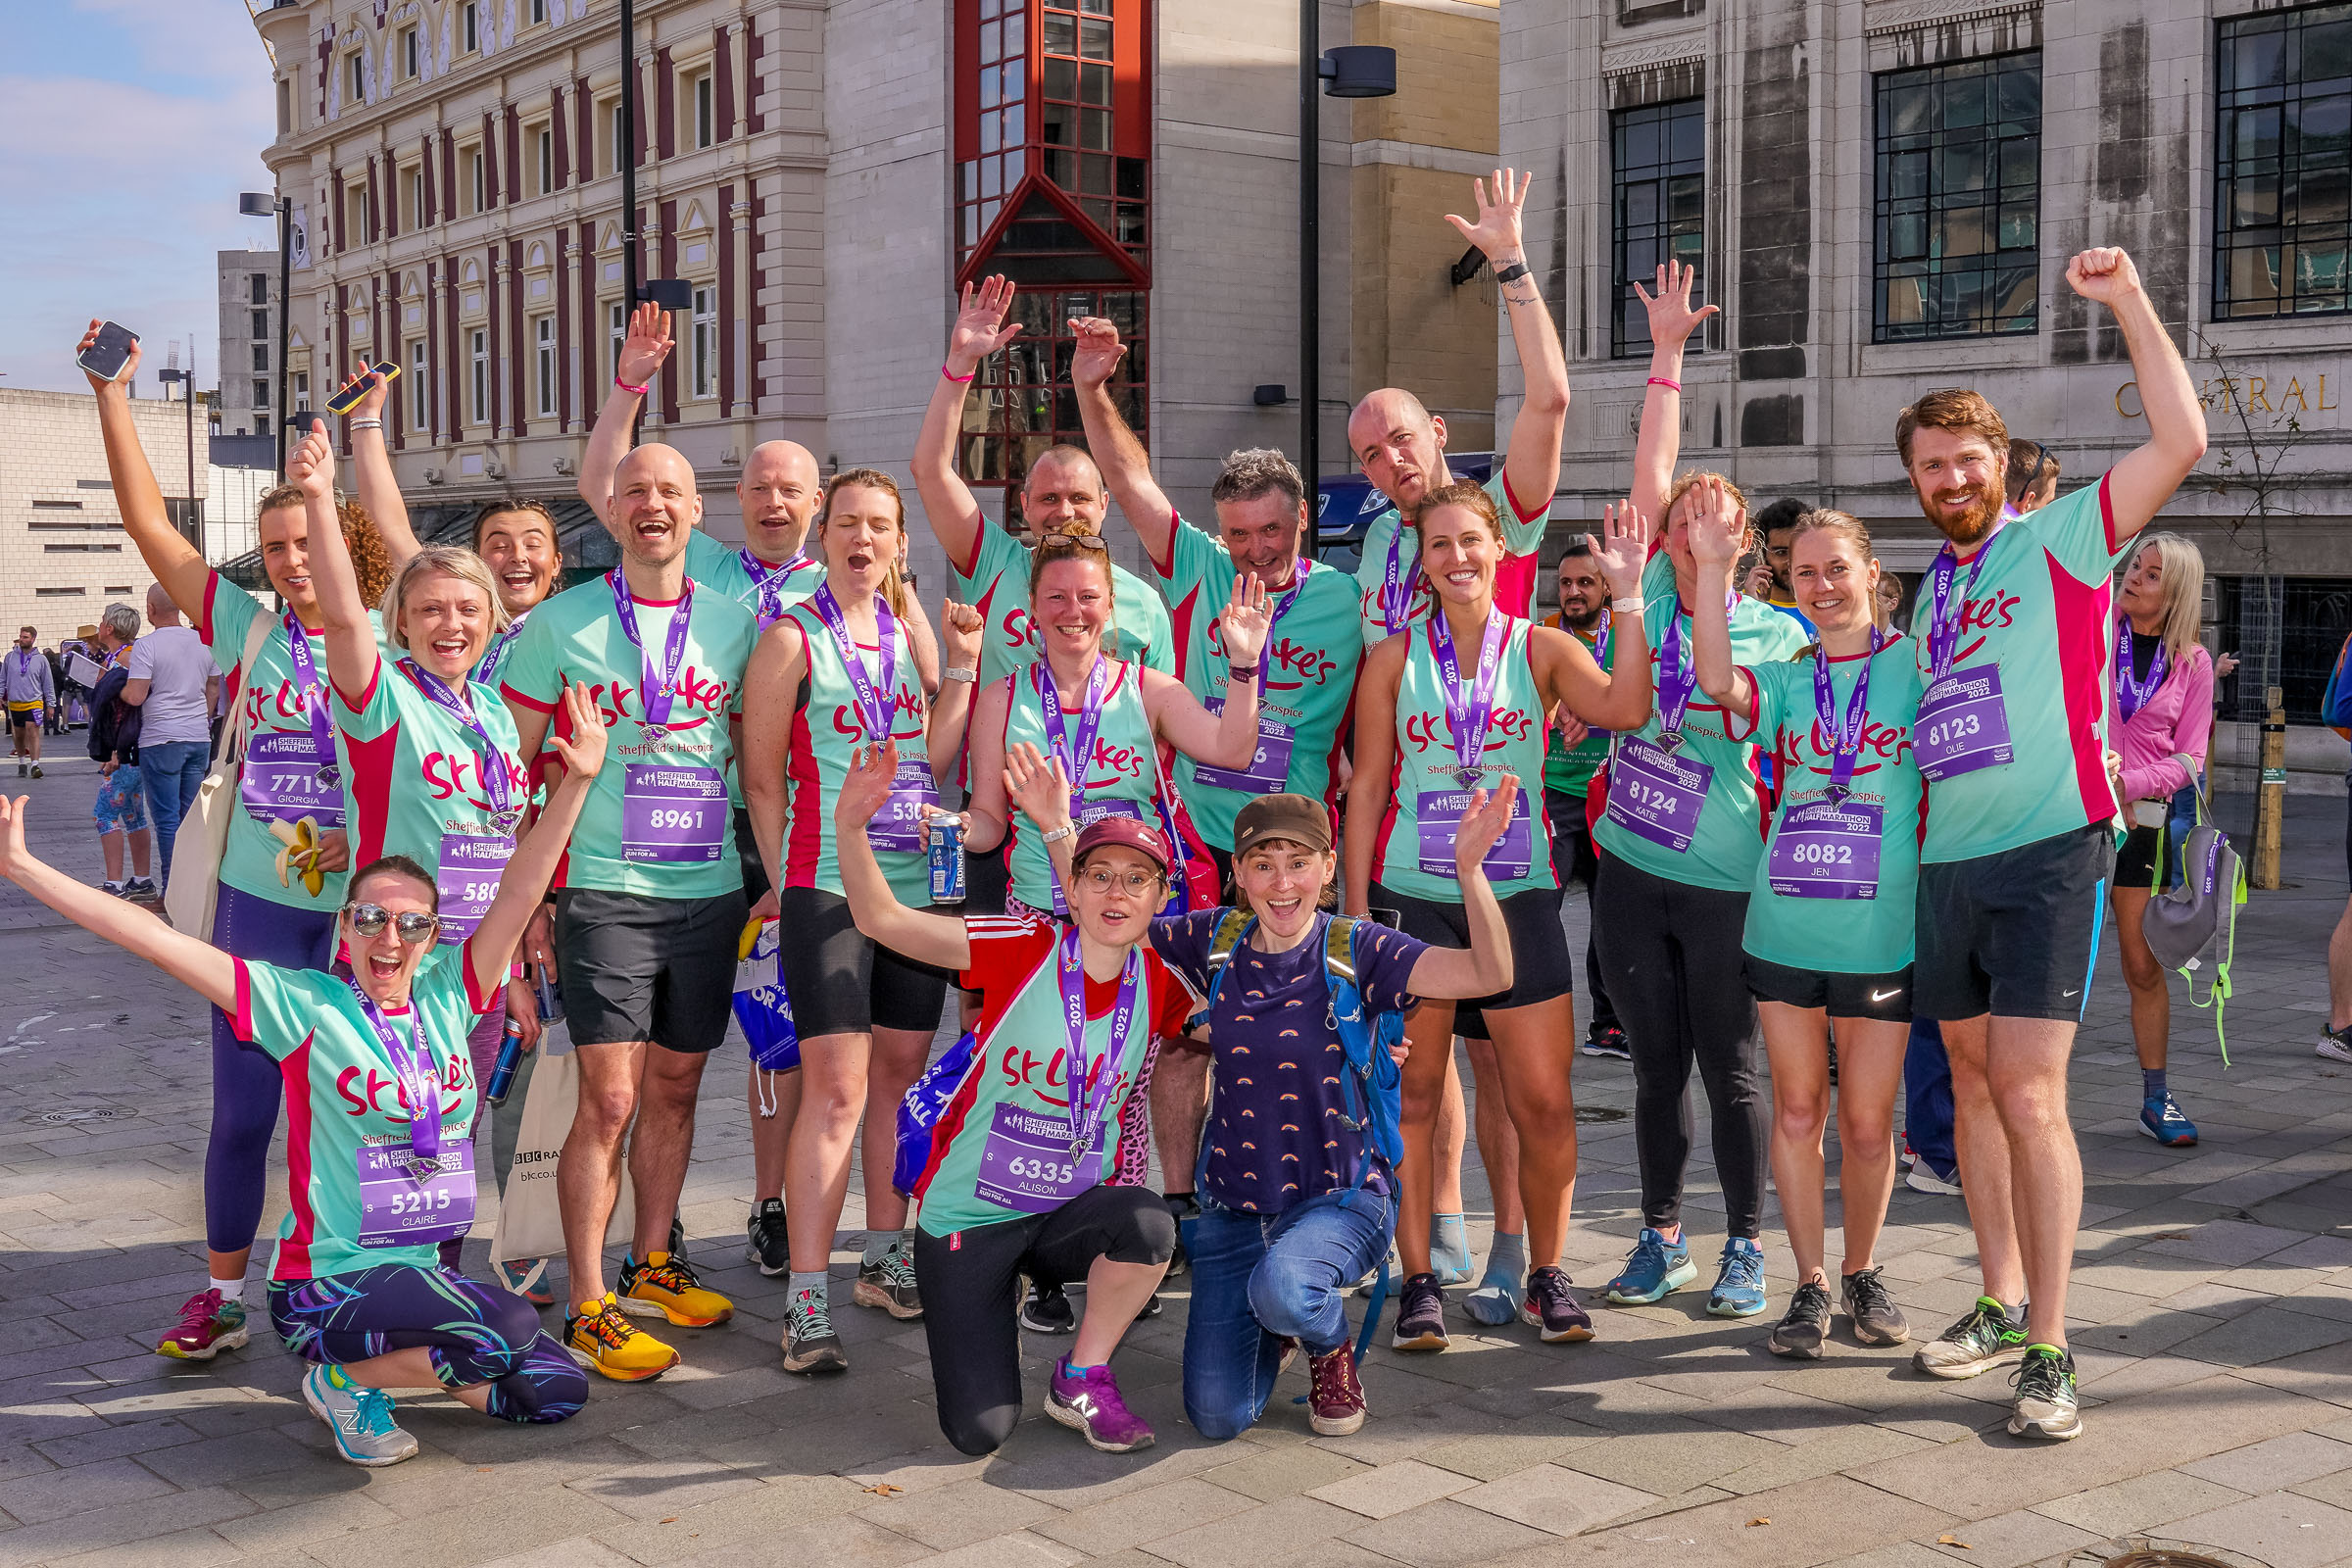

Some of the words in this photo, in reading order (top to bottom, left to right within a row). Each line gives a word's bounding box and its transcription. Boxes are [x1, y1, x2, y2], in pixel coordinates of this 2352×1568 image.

[2115, 374, 2337, 418] CTRAL
[1388, 560, 1396, 587] 2022
[1937, 569, 1950, 598] 2022
[294, 641, 309, 667] 2022
[1271, 638, 1337, 686] ke's
[1483, 643, 1496, 668] 2022
[1093, 663, 1106, 689] 2022
[1446, 659, 1457, 685] 2022
[640, 665, 732, 717] ke's
[857, 677, 873, 706] 2022
[1930, 692, 1944, 704] HALF
[1943, 678, 1989, 698] MARATHON
[1968, 687, 1990, 699] 2022
[1045, 691, 1057, 718] 2022
[1268, 705, 1303, 718] ospice
[1264, 726, 1285, 736] 2022
[1406, 710, 1441, 753] St
[1446, 698, 1532, 742] ke's
[1683, 720, 1724, 741] Hospice
[1811, 710, 1912, 766] Lke's
[1930, 714, 1981, 746] 8123
[617, 743, 674, 757] Sheffield's
[677, 743, 714, 755] Hospice
[1091, 737, 1144, 777] ke's
[1643, 747, 1677, 766] SHEFFIELD
[1945, 742, 1965, 755] OLIE
[422, 751, 469, 800] St
[1642, 755, 1658, 768] HALF
[1657, 762, 1701, 783] MARATHON
[270, 774, 328, 794] 7719
[1678, 777, 1699, 790] 2022
[277, 795, 319, 805] GIORGIA
[1629, 781, 1677, 815] 8124
[1849, 790, 1886, 803] ospice
[651, 808, 704, 829] 8961
[893, 803, 923, 820] 530
[1635, 806, 1658, 821] KATIE
[1821, 813, 1870, 824] MARATHON
[1846, 823, 1870, 832] 2022
[1792, 844, 1852, 863] 8082
[463, 882, 500, 902] 580
[752, 986, 776, 1009] OR
[1068, 994, 1082, 1028] 2022
[1114, 1007, 1129, 1040] 2022
[415, 1021, 429, 1051] 2022
[1002, 1046, 1043, 1086] St
[336, 1065, 392, 1116] St
[906, 1094, 932, 1127] ALL
[440, 1121, 467, 1135] spice
[1024, 1126, 1046, 1136] HALF
[1025, 1117, 1066, 1131] SHEFFIELD
[515, 1151, 542, 1164] BBC
[987, 1152, 994, 1161] S
[1009, 1155, 1073, 1184] 6335
[1018, 1181, 1057, 1195] ALISON
[367, 1203, 373, 1212] S
[391, 1189, 451, 1215] 5215
[402, 1214, 437, 1227] CLAIRE
